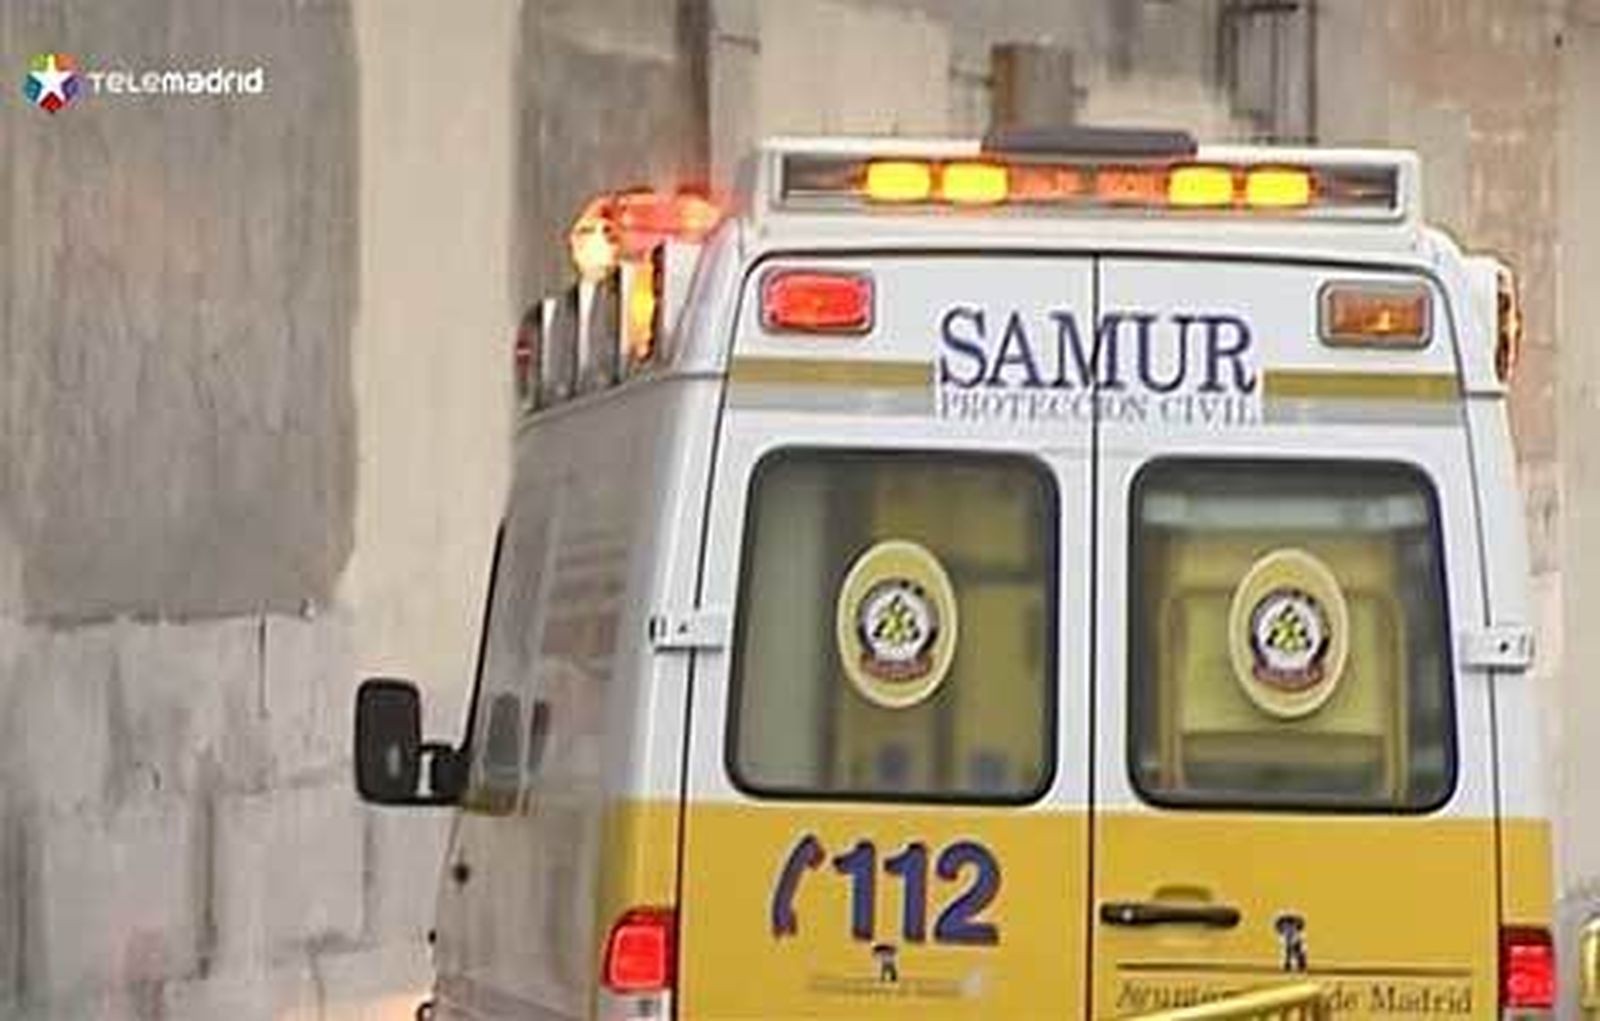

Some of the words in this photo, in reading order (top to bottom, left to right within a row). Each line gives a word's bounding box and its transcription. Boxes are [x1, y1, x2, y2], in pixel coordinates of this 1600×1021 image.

[939, 306, 1257, 394] SAMUR
[938, 389, 1150, 422] PROTECCON
[832, 840, 1001, 946] 112
[1369, 984, 1473, 1014] Madrid
